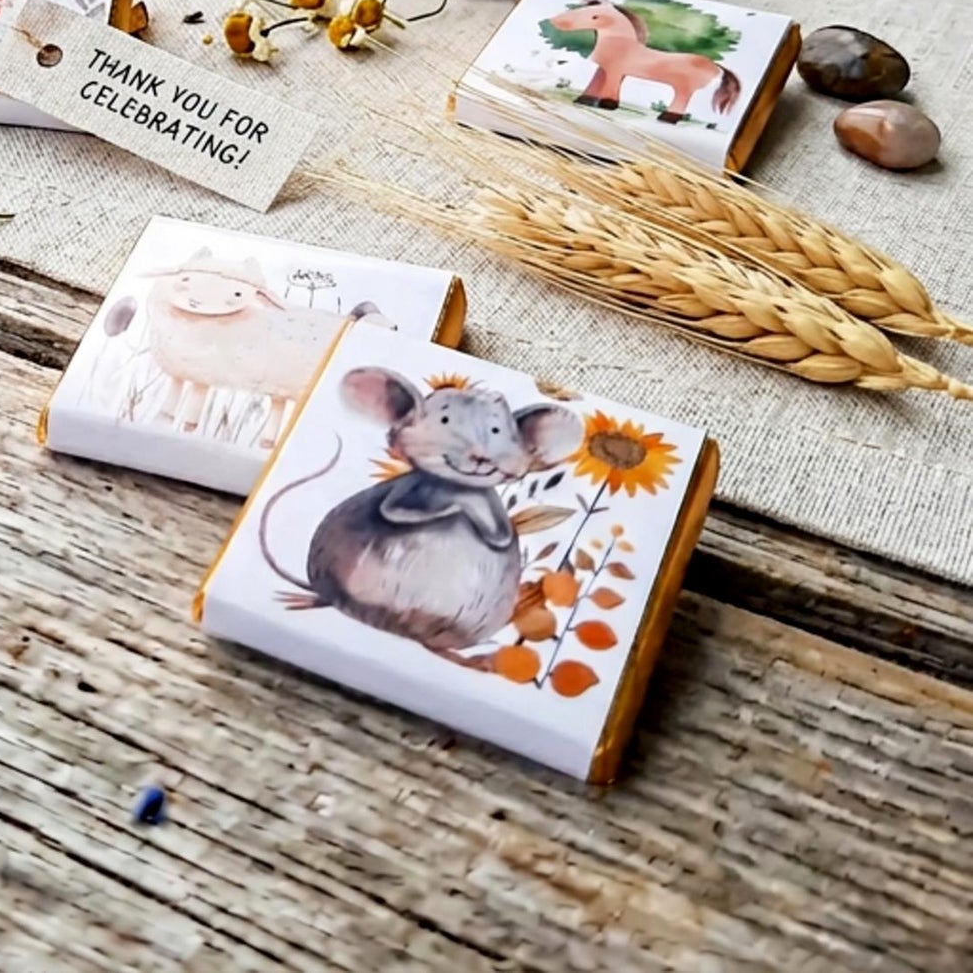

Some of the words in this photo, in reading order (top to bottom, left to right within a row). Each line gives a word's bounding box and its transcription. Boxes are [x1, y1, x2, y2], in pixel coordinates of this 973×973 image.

[80, 81, 250, 170] CELEBRATING!
[85, 48, 166, 97] THANK
[171, 85, 218, 120] YOU
[219, 108, 269, 144] FOR
